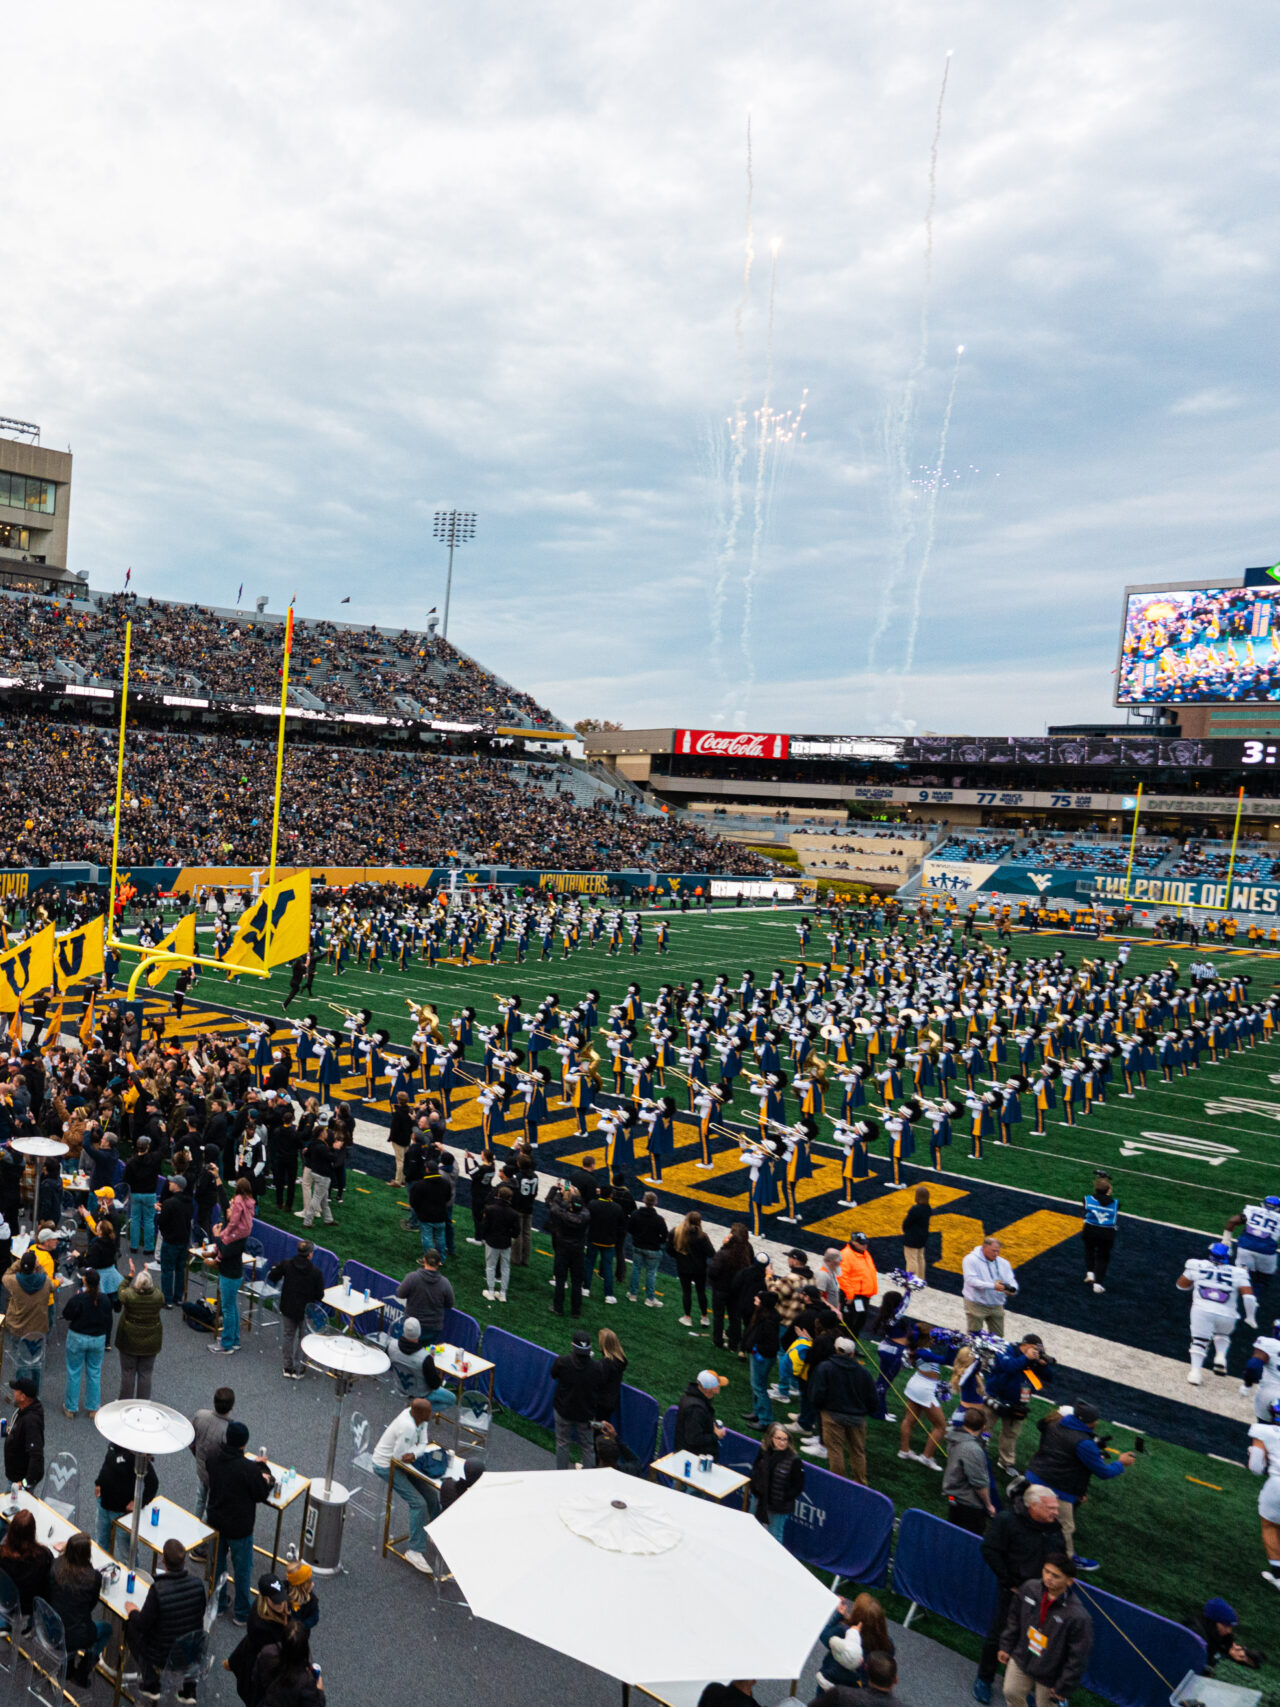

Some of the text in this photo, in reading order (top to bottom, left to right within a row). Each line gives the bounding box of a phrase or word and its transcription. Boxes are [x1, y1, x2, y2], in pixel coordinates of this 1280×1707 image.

[696, 732, 769, 756] Coca-Cola
[919, 790, 929, 801] 9
[976, 792, 997, 804] 77
[1050, 794, 1072, 807] 75
[1147, 799, 1248, 813] DIVERSIFIED
[1135, 878, 1198, 905] PRIDE
[1231, 886, 1280, 912] WES
[794, 1499, 826, 1527] IETY
